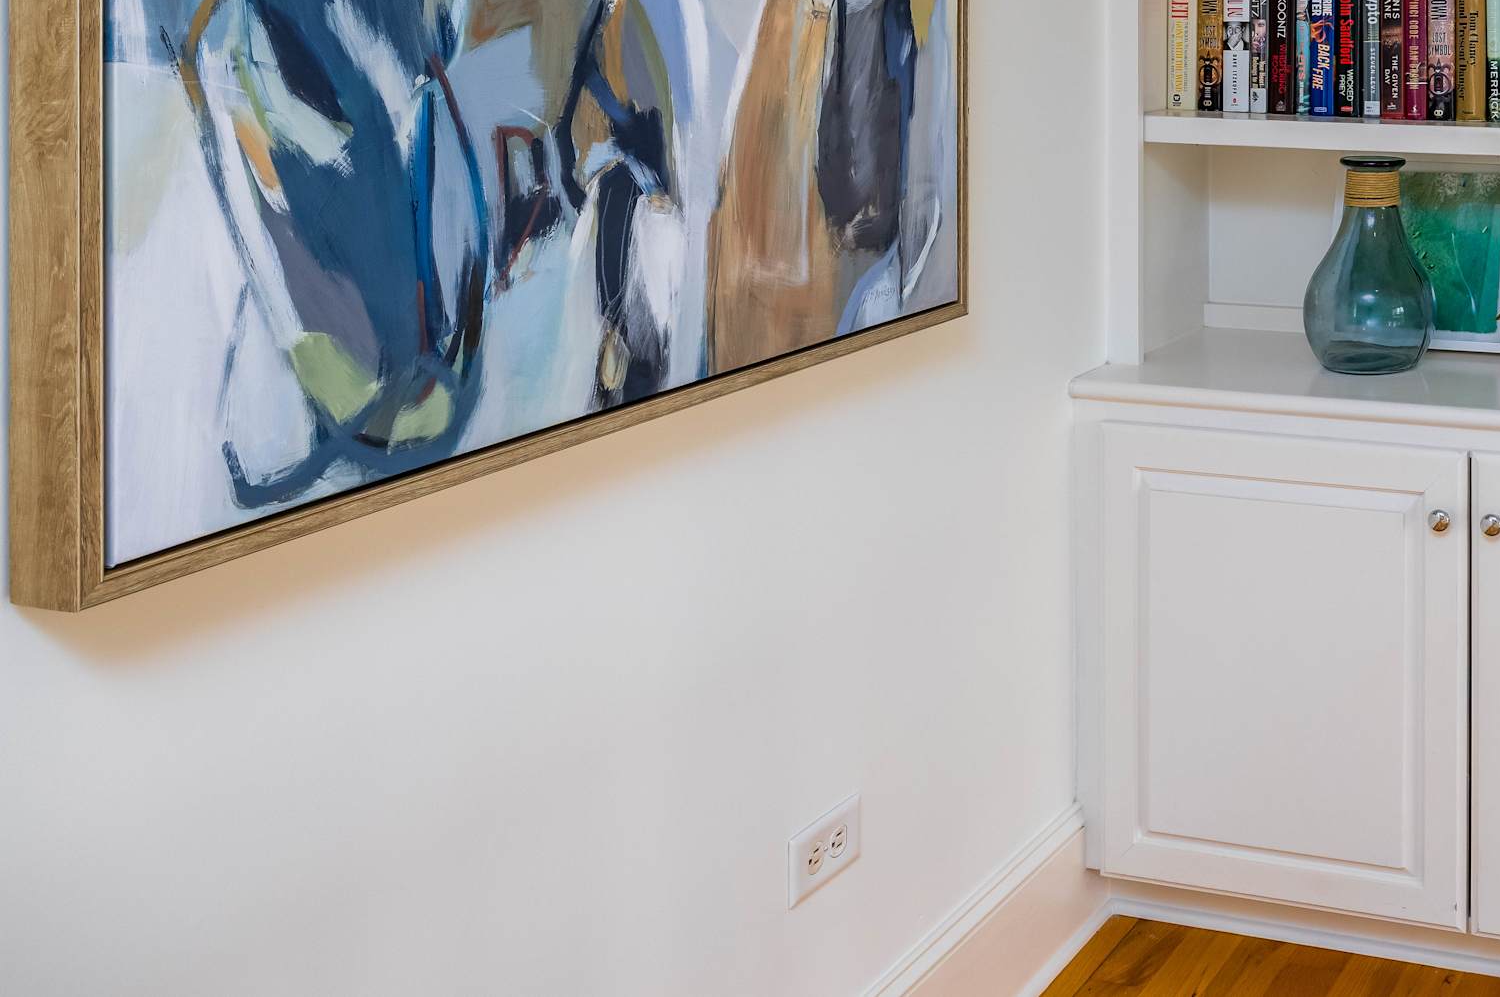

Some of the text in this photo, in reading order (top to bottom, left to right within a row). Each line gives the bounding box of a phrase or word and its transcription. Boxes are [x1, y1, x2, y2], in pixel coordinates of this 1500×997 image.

[1339, 19, 1354, 65] Sandford
[1408, 19, 1419, 40] CODE
[1458, 21, 1468, 61] Present
[1466, 10, 1480, 66] Tom Clancy
[1317, 44, 1330, 69] BACK
[1408, 45, 1419, 61] DAN
[1312, 68, 1324, 91] FIRE
[1339, 74, 1347, 97] PREY
[1391, 55, 1399, 99] THE GIVEN
[1455, 63, 1468, 101] Danger
[1490, 60, 1499, 119] MERRICK
